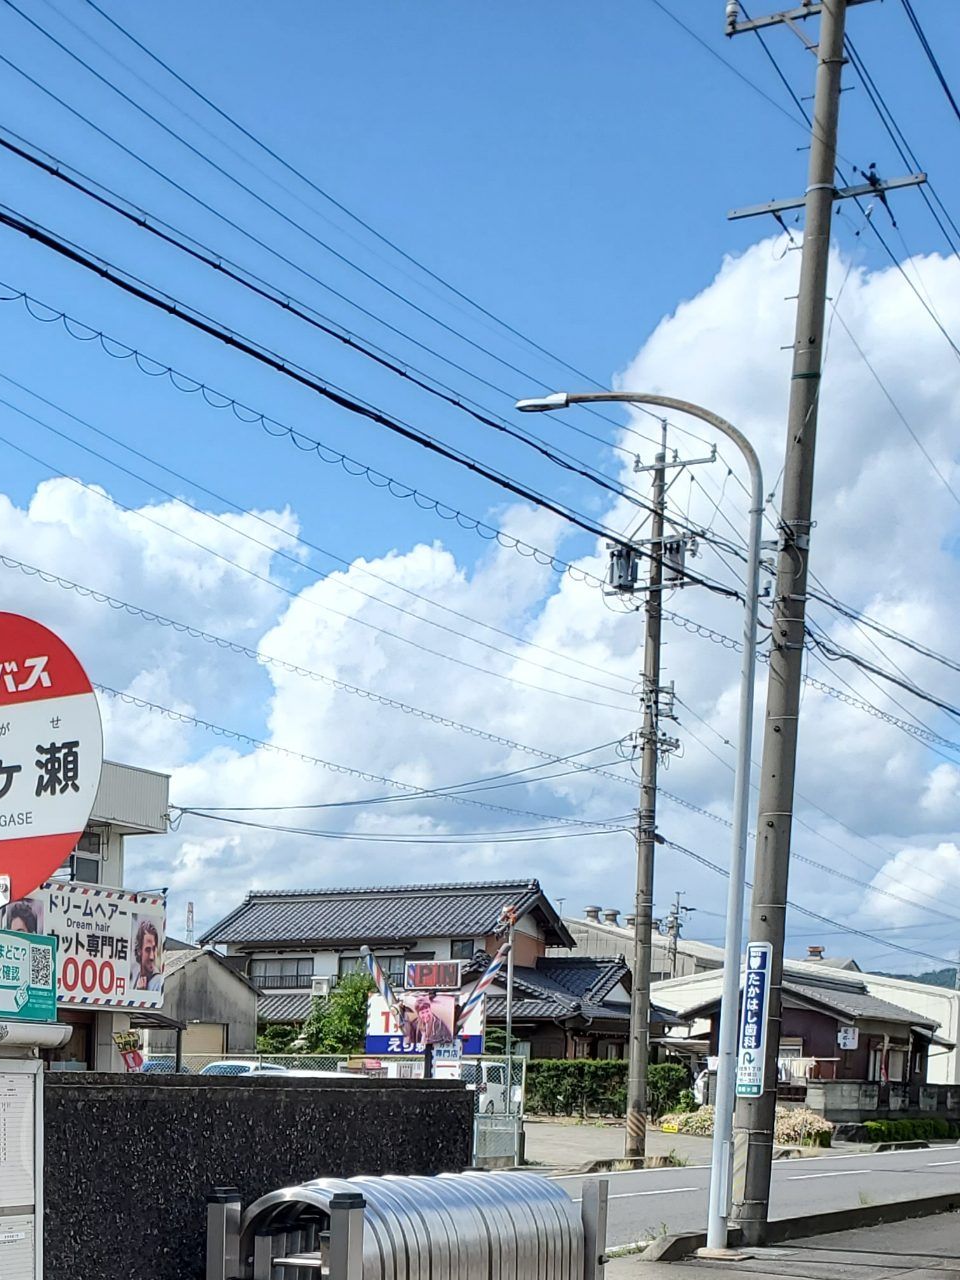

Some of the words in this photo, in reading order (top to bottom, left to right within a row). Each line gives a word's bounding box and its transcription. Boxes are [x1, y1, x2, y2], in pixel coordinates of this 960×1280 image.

[0, 722, 10, 737] が
[49, 716, 62, 729] せ
[49, 893, 127, 920] ドリームヘアー
[66, 918, 93, 931] Dream
[95, 922, 110, 932] hair
[57, 957, 125, 996] ,000円
[743, 973, 760, 1049] たかはし歯科
